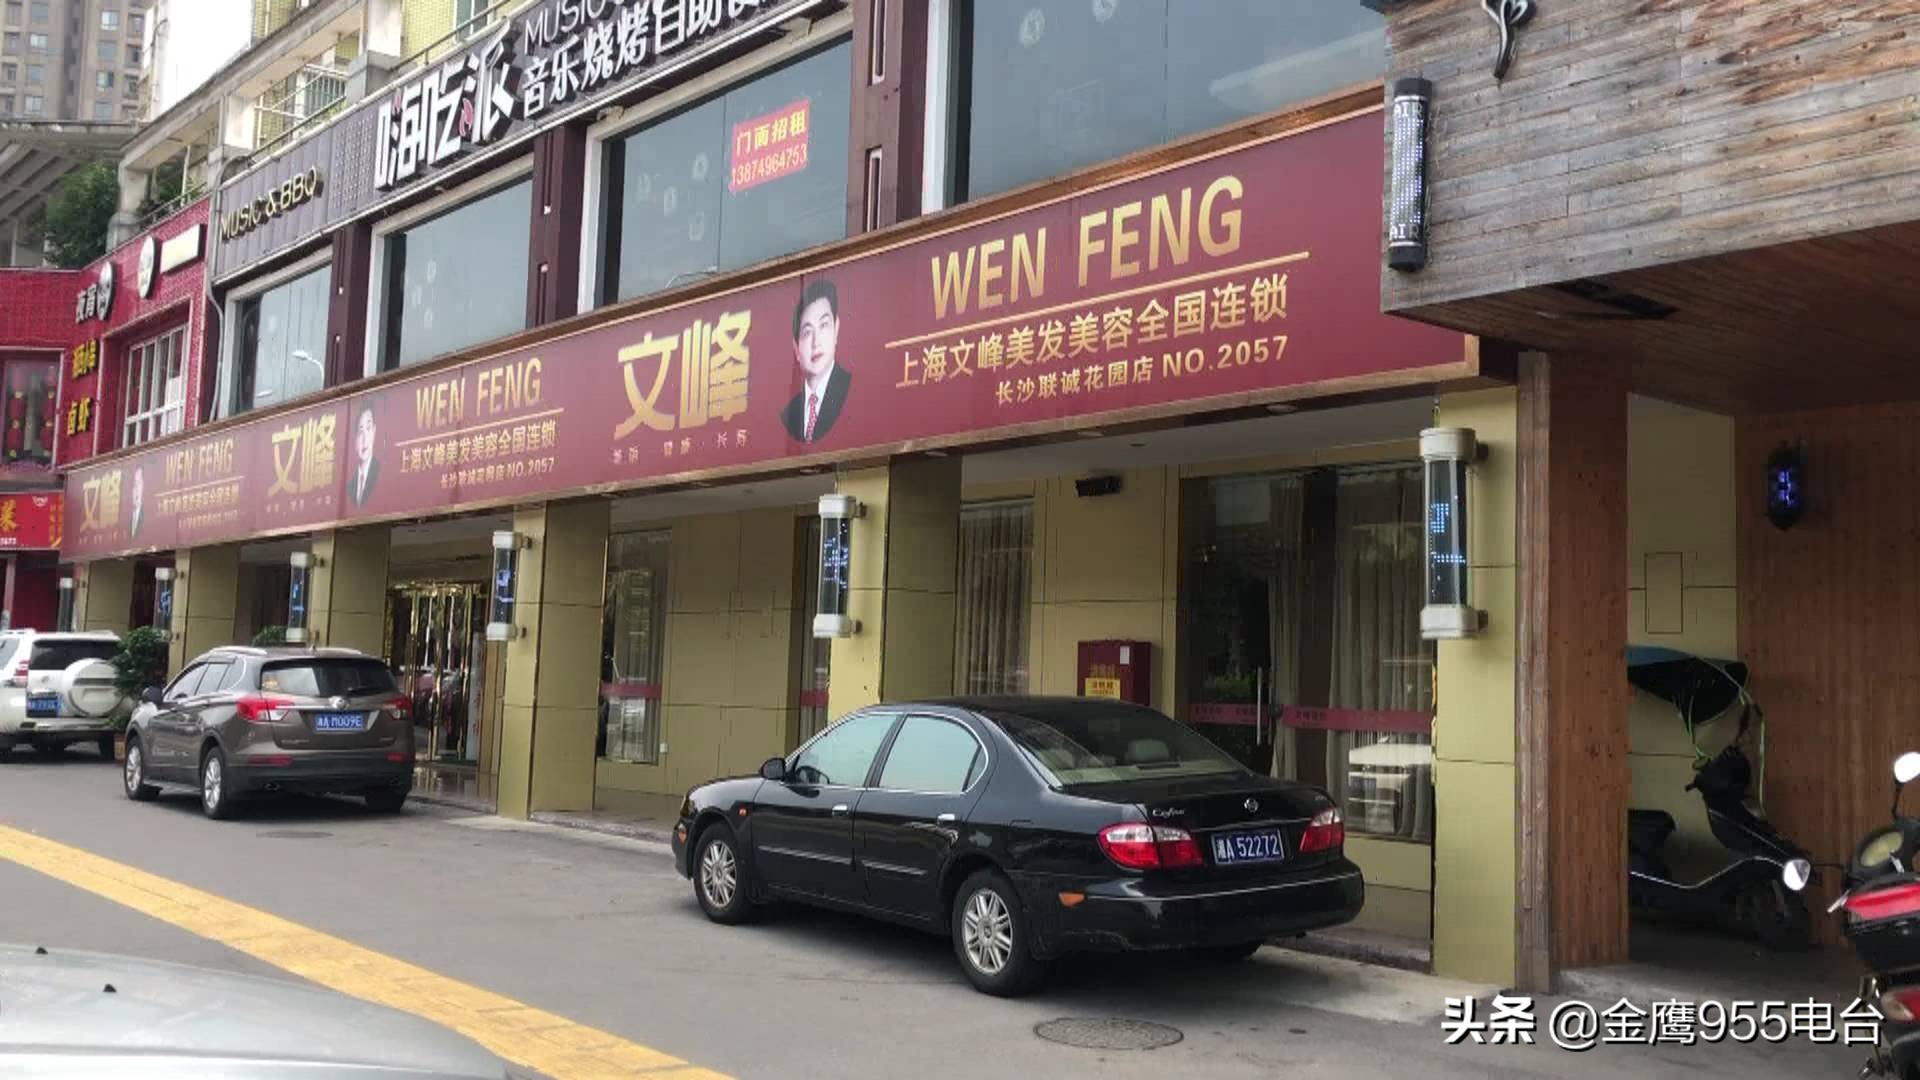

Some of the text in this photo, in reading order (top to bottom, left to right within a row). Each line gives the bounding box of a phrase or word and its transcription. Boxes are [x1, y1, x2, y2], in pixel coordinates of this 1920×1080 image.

[732, 143, 807, 186] 13874964753
[736, 109, 806, 157] 门面招租
[219, 165, 319, 239] MUSIC & BBQ
[931, 175, 1243, 321] WEN FENG
[896, 274, 1288, 388] 上海文峰美发美容全国连锁
[416, 357, 542, 429] WEN FENG
[614, 310, 751, 440] 文峰
[995, 356, 1153, 406] 长沙联诚花园店
[166, 438, 234, 482] WEN FENG
[267, 413, 337, 496] 文峰
